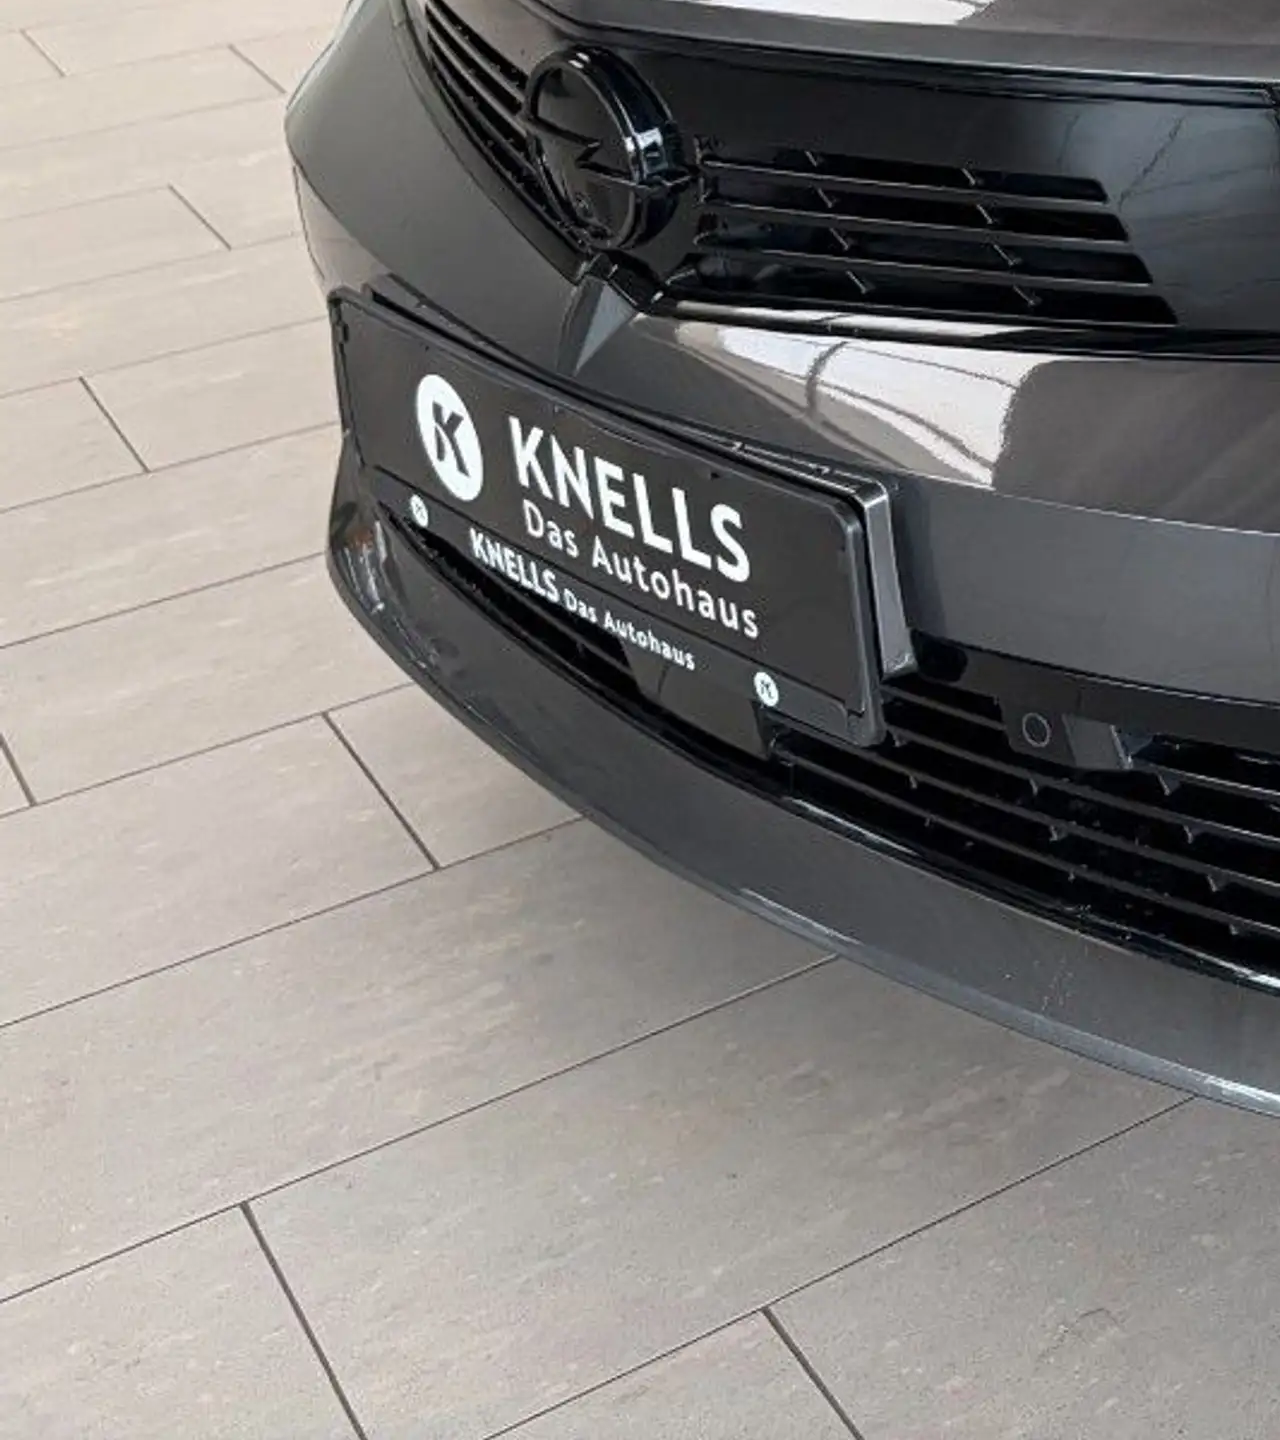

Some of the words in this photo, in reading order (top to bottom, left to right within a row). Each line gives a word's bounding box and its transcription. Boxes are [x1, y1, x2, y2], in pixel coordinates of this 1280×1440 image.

[508, 415, 751, 583] KNELLS
[523, 499, 580, 558] Das
[592, 536, 760, 639] Autohaus
[469, 527, 560, 603] KNELLS
[563, 588, 598, 623] Das
[603, 610, 696, 671] Autohaus
